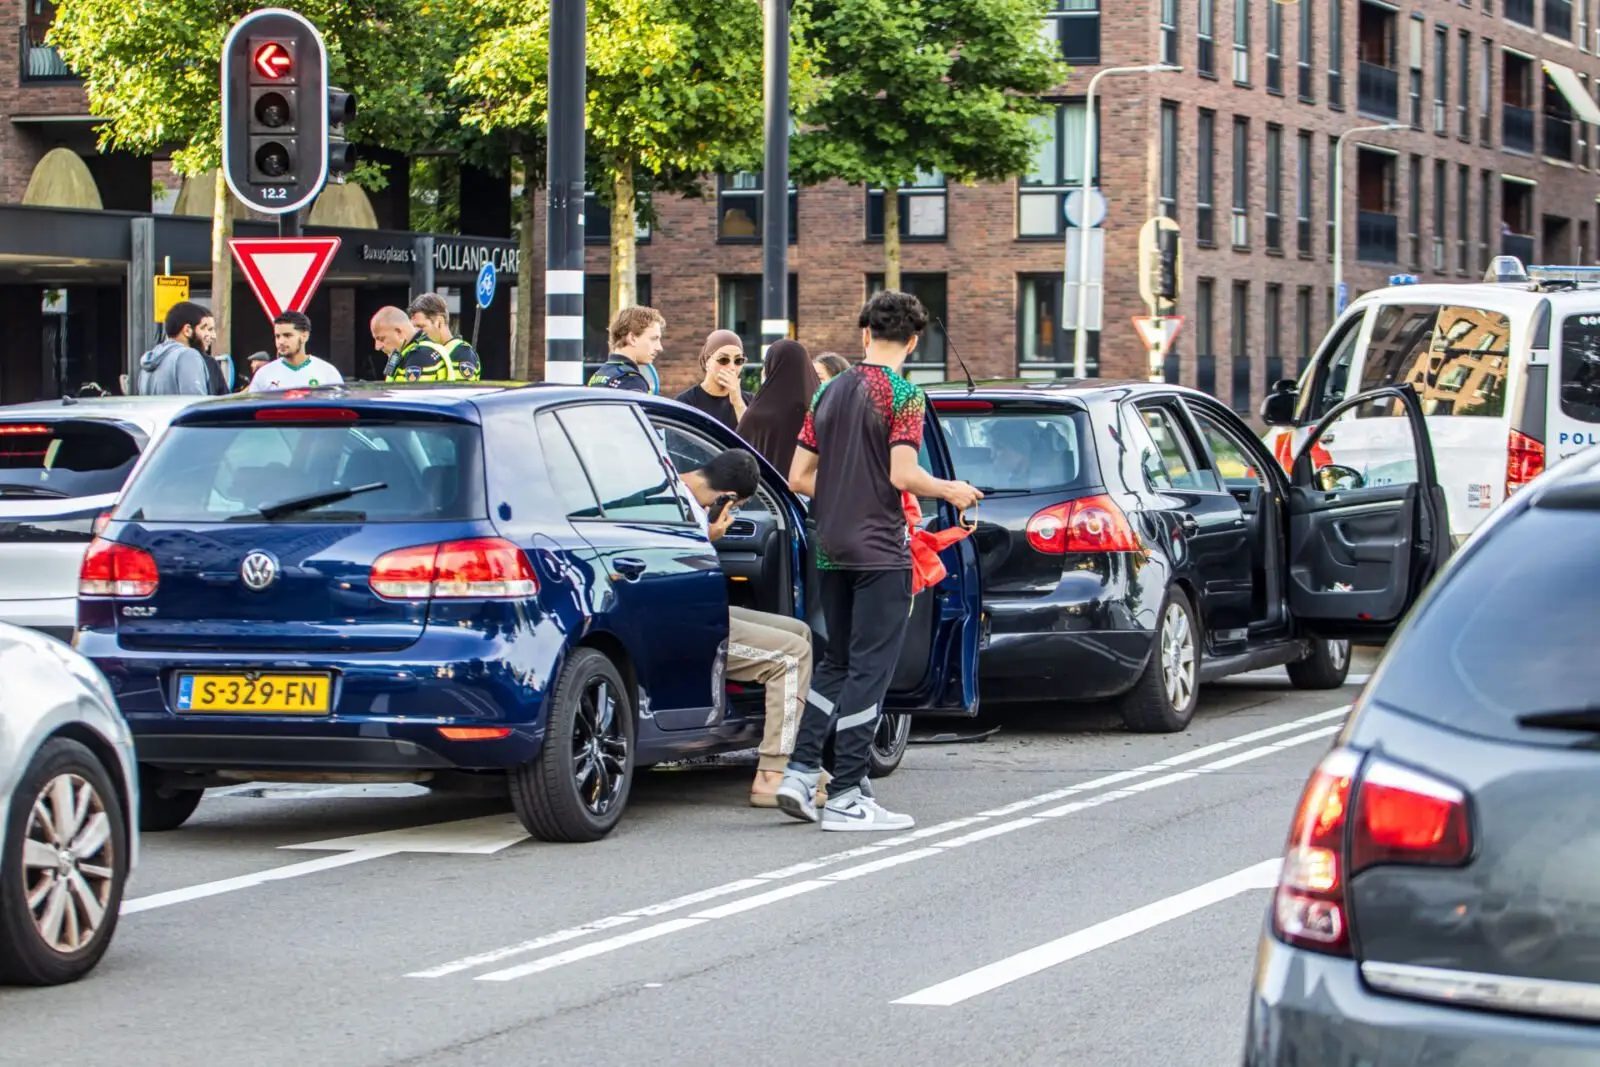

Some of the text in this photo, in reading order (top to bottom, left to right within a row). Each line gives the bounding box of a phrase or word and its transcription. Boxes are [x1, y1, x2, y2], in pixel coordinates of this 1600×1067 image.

[261, 187, 287, 199] 12.2
[122, 605, 159, 617] GOLF
[201, 681, 317, 706] S-329-FN
